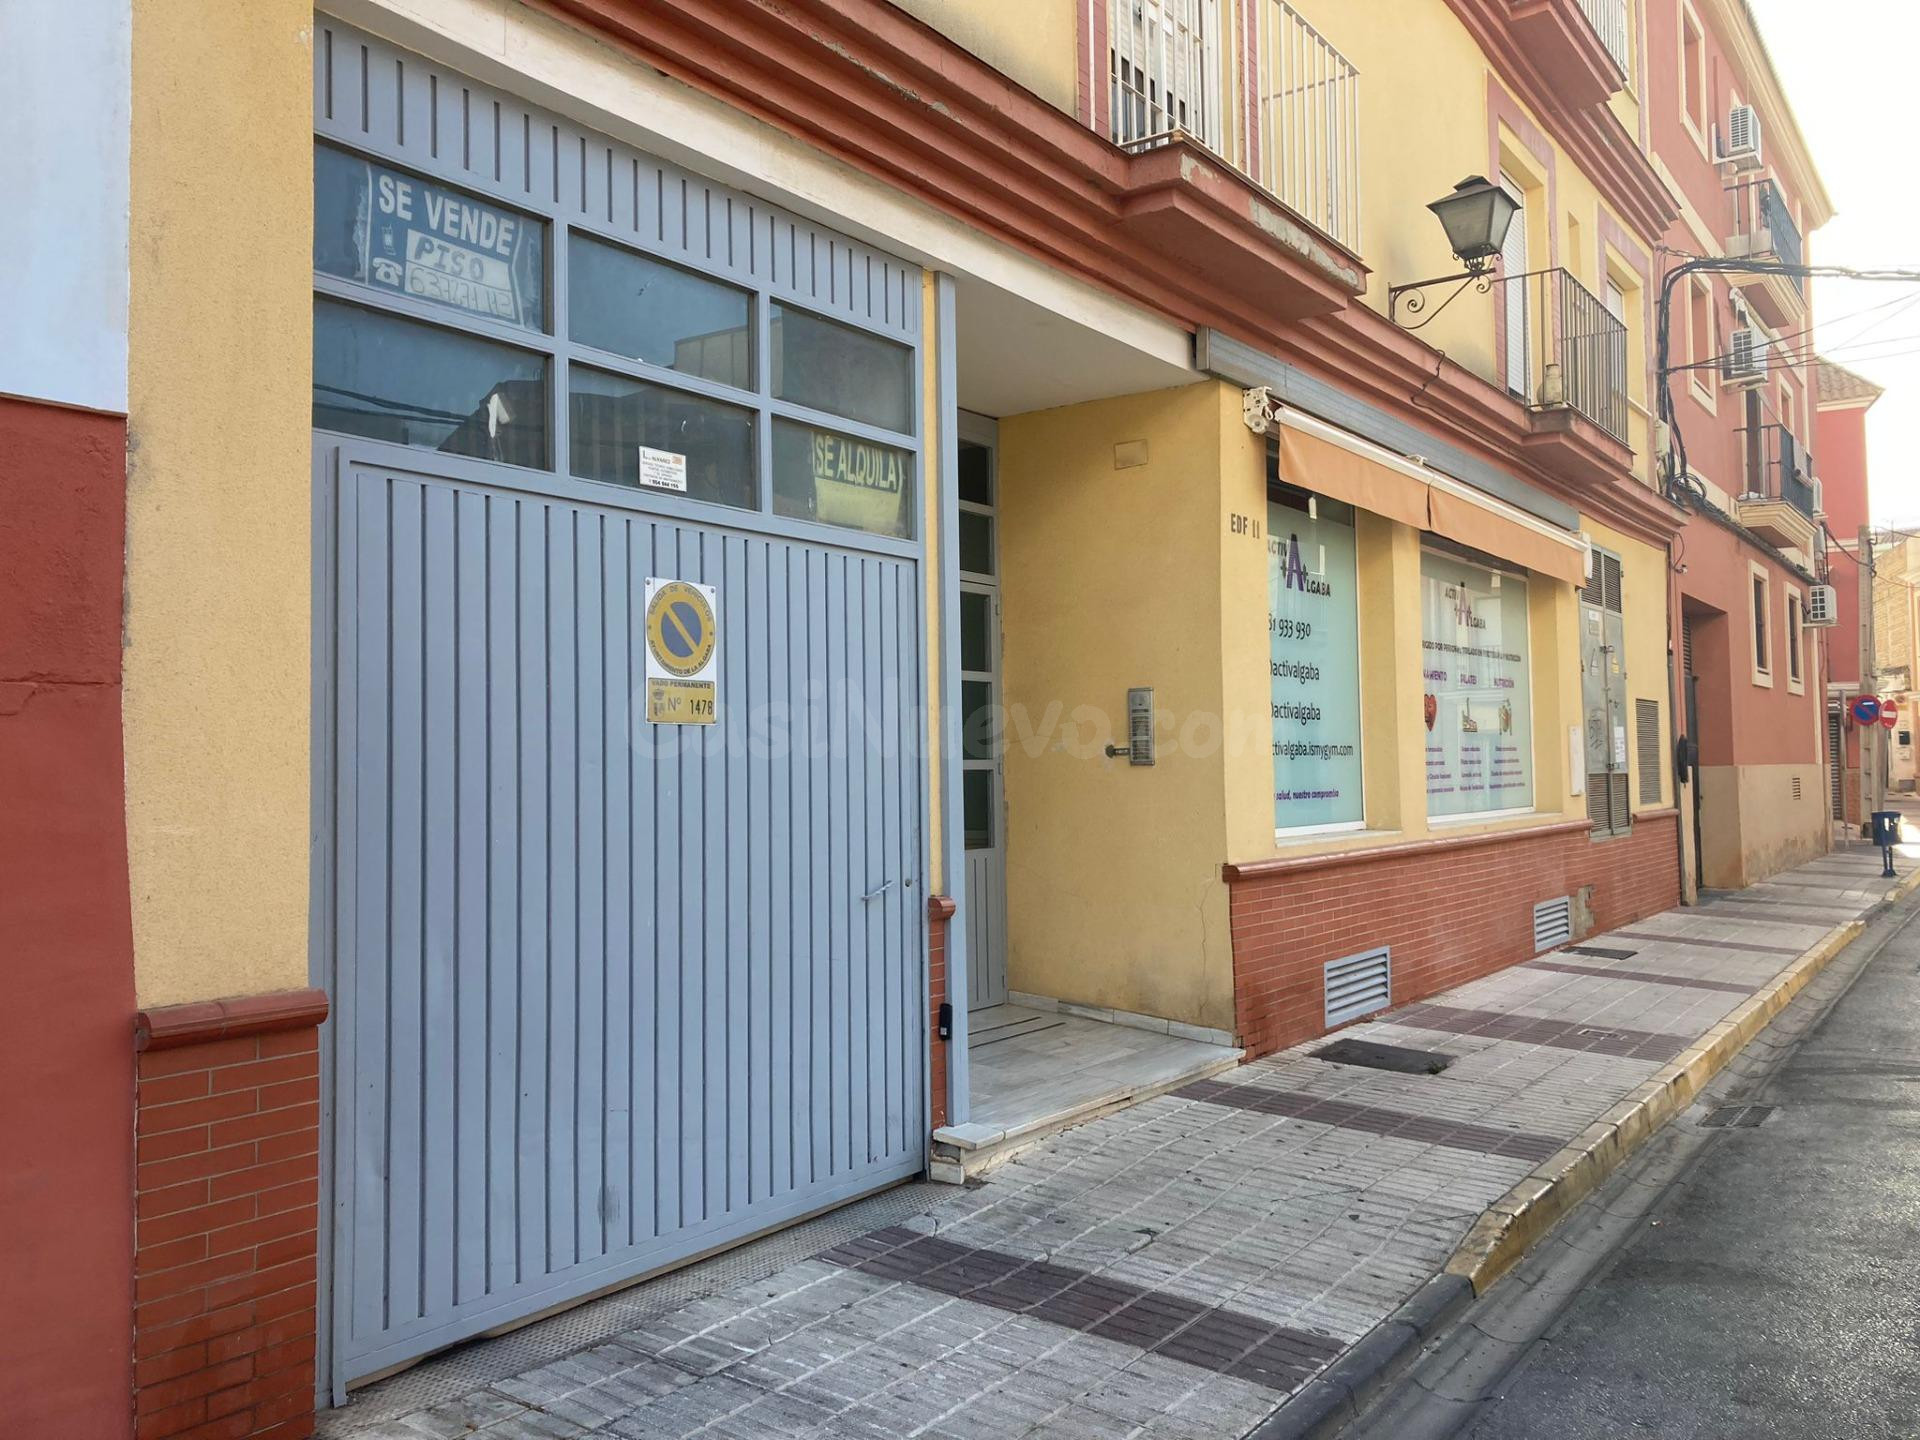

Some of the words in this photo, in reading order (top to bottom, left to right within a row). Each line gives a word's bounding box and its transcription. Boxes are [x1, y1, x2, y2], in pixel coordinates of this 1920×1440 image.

[379, 174, 413, 222] SE
[424, 190, 516, 257] VENDE
[413, 236, 485, 281] PISO
[815, 434, 834, 478] SE
[836, 439, 898, 491] ALQUILA
[1230, 513, 1249, 535] EDF
[1306, 579, 1332, 597] LGABA
[1279, 618, 1294, 639] 933
[1295, 620, 1311, 640] 930
[1269, 659, 1320, 685] activalgaba
[652, 680, 669, 688] VADO
[669, 681, 712, 690] PERMANENTE
[689, 699, 713, 716] 1478
[1271, 701, 1321, 726] activalgaba
